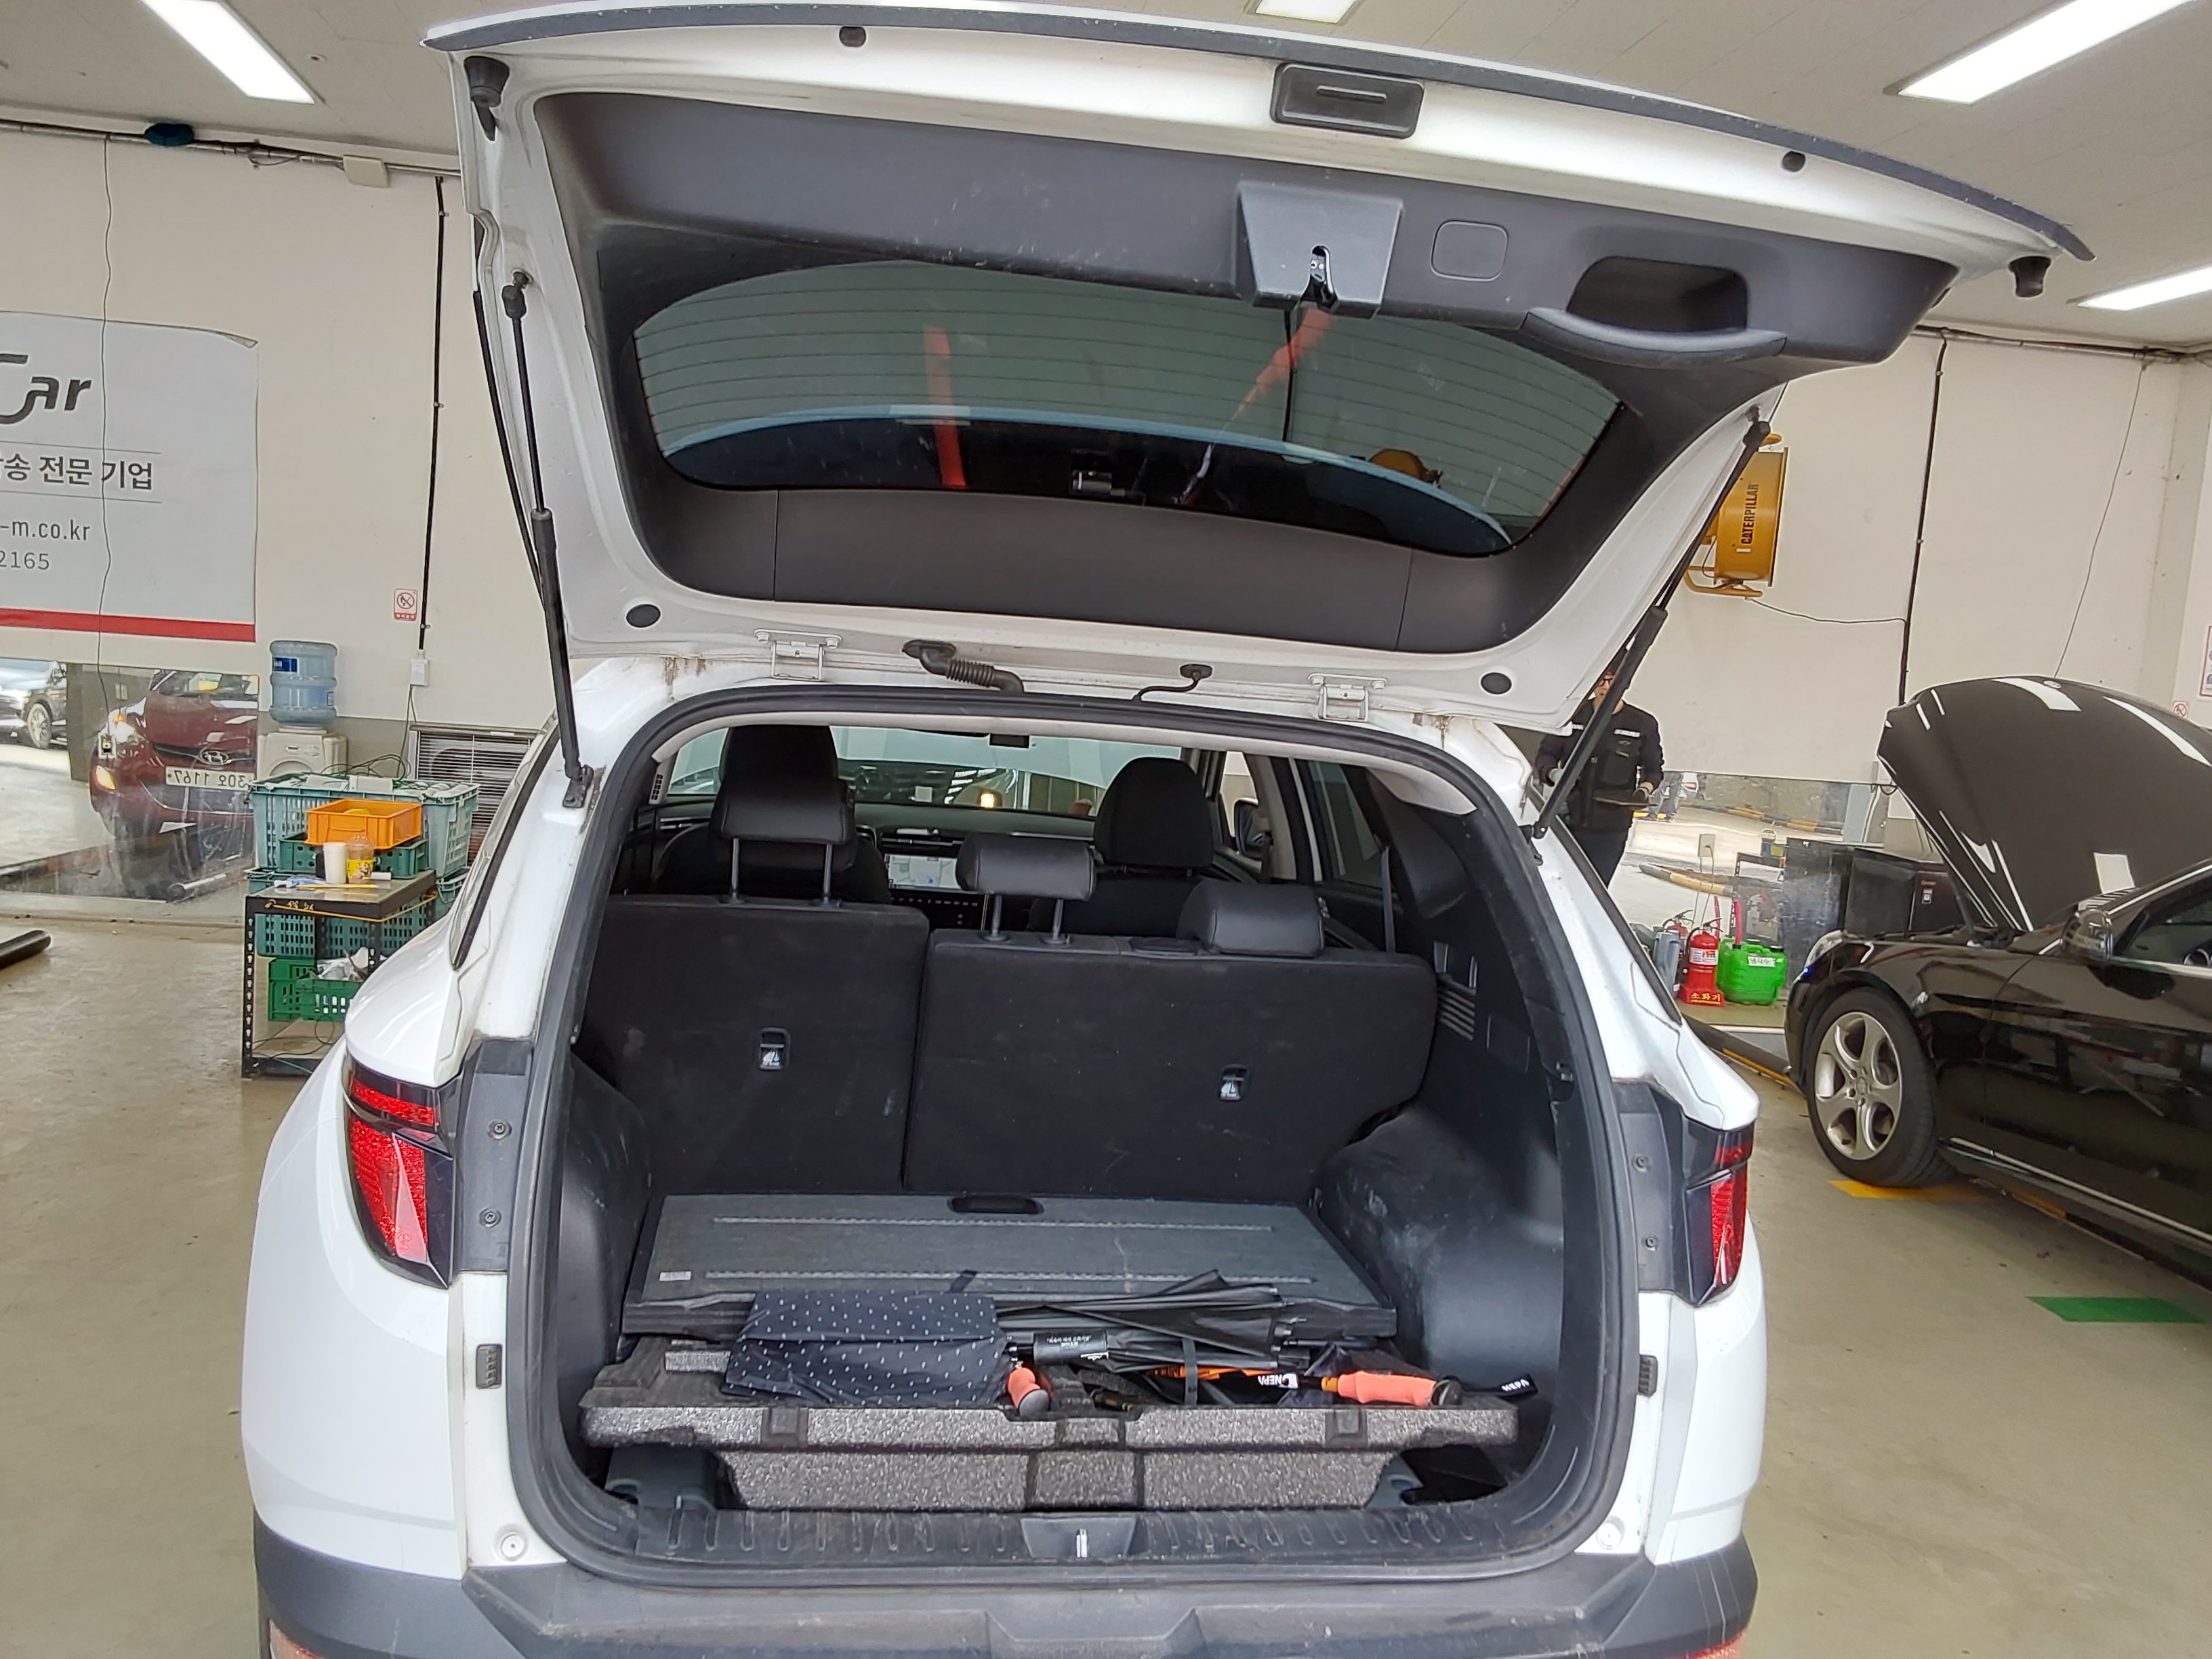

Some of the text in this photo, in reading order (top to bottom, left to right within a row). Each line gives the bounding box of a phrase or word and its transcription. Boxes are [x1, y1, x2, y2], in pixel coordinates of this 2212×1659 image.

[0, 453, 152, 490] 송 전문 기업
[1740, 484, 1759, 545] CATERPILLAR
[0, 550, 49, 570] 2165
[1691, 992, 1721, 1002] 소화기
[1258, 1374, 1282, 1386] NEPA
